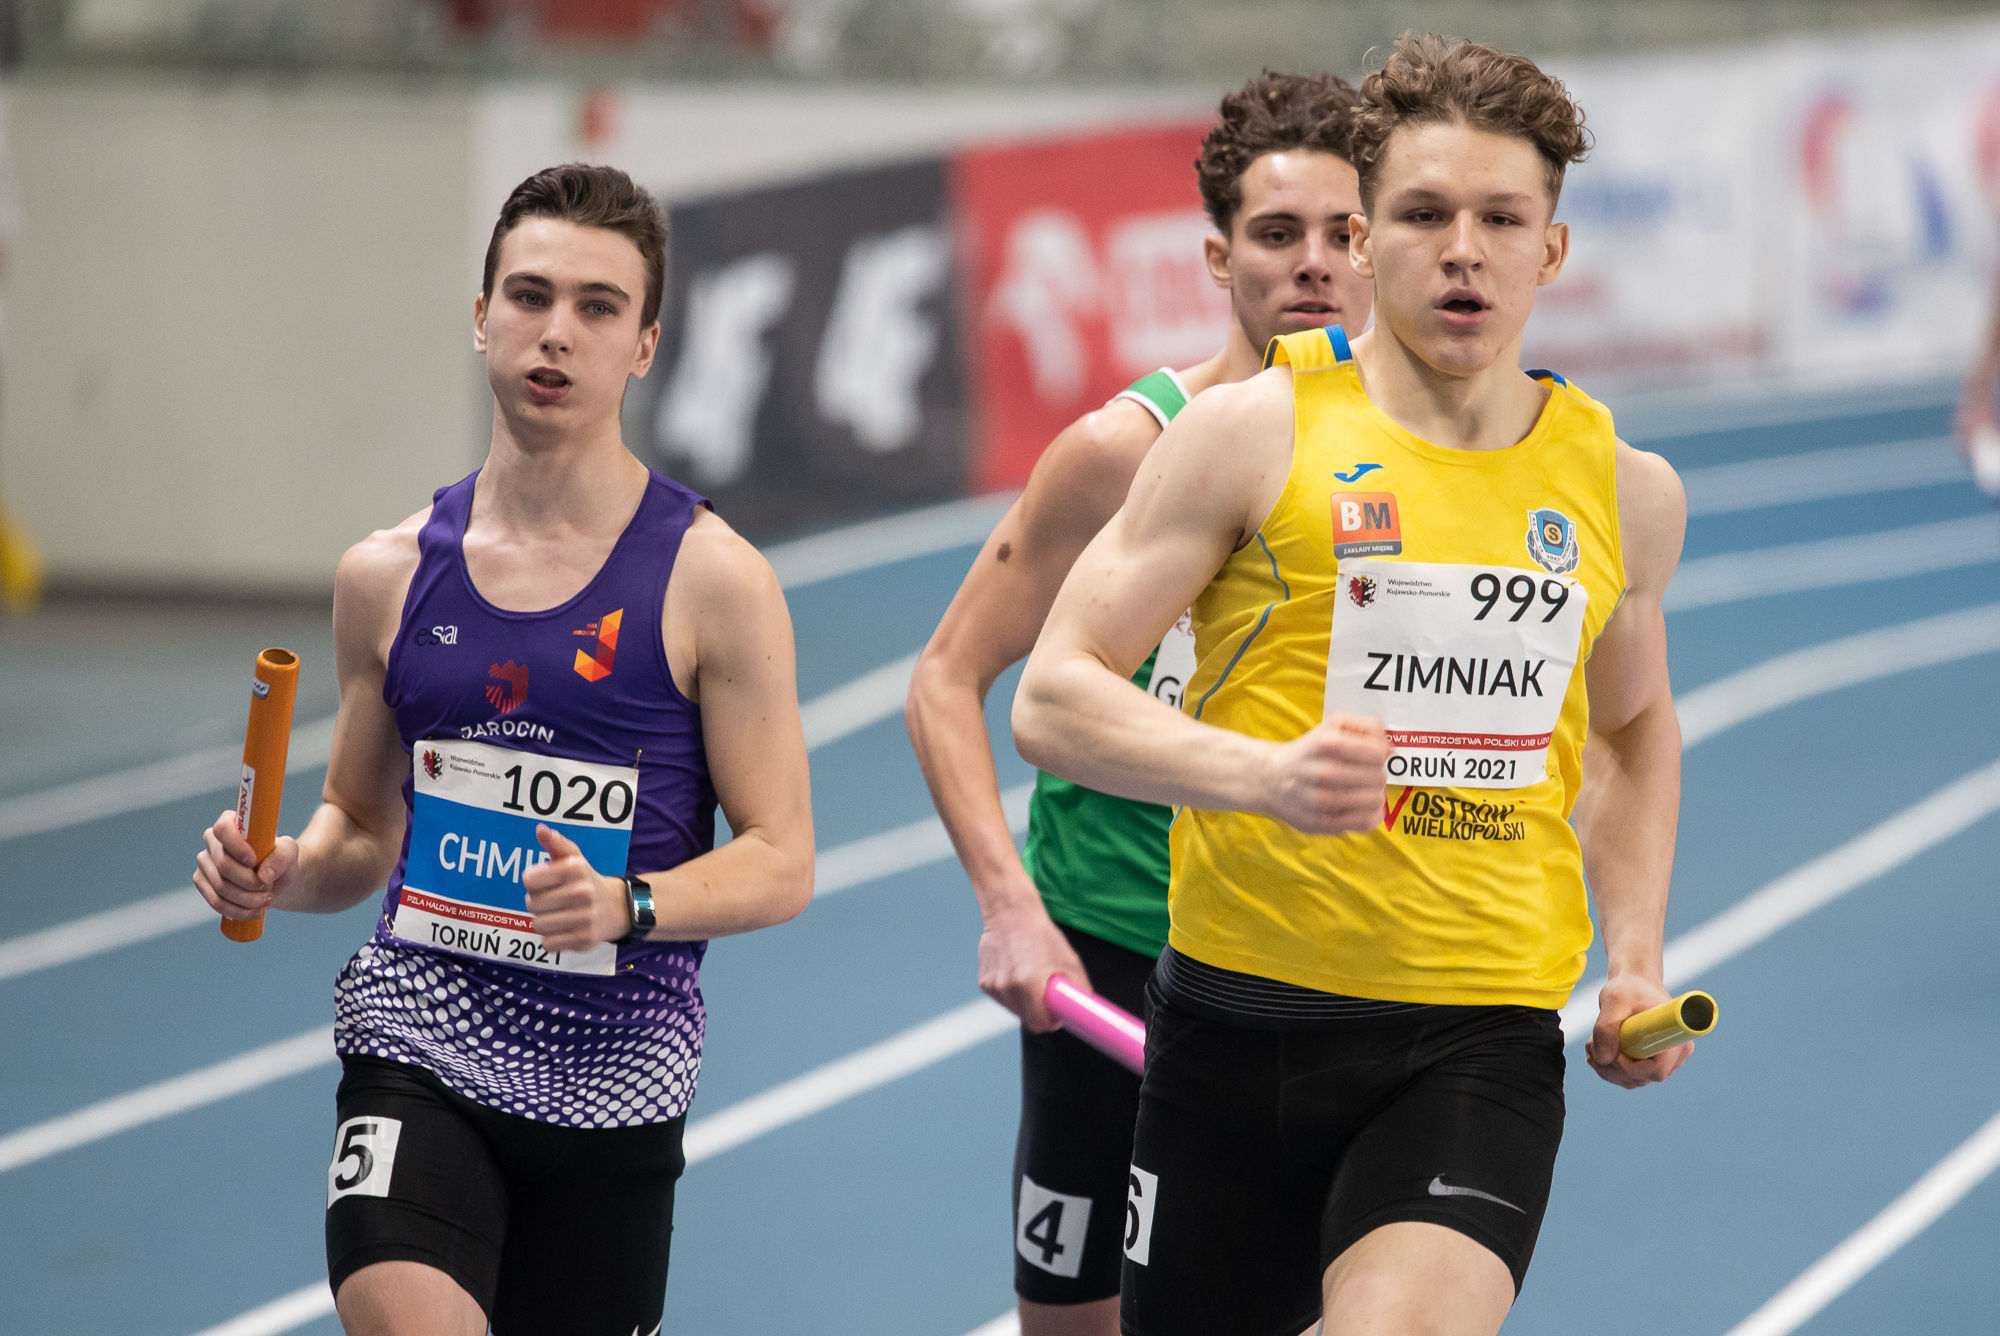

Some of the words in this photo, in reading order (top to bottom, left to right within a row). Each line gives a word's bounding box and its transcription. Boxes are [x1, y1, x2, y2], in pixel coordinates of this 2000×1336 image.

[1340, 501, 1391, 531] BM
[1343, 545, 1371, 555] ZAKŁADY
[1371, 545, 1394, 553] MIĘSNE
[1386, 588, 1451, 598] Kujawsko-Pomorskie
[1387, 578, 1433, 587] Województwo
[1470, 573, 1569, 623] 999
[1363, 652, 1546, 697] ZIMNIAK
[460, 720, 555, 744] JAROCIN
[1410, 735, 1482, 746] MISTRZOSTWA
[1483, 738, 1519, 747] POLSKI
[1520, 738, 1536, 747] U18
[449, 763, 501, 780] Kujawsko-Pomorskie
[450, 754, 486, 768] Województwo
[1386, 751, 1456, 779] ORUŃ
[1463, 758, 1517, 780] 2021
[503, 764, 634, 824] 1020
[1411, 791, 1515, 824] OSTRÓW
[1403, 815, 1525, 841] WIELKOPOLSKI
[406, 894, 425, 907] PZLA
[425, 901, 457, 916] HALOWE
[458, 909, 527, 929] MISTRZOSTWA
[431, 922, 501, 956] TORUŃ
[335, 1123, 378, 1191] 5
[1024, 1200, 1064, 1265] 4
